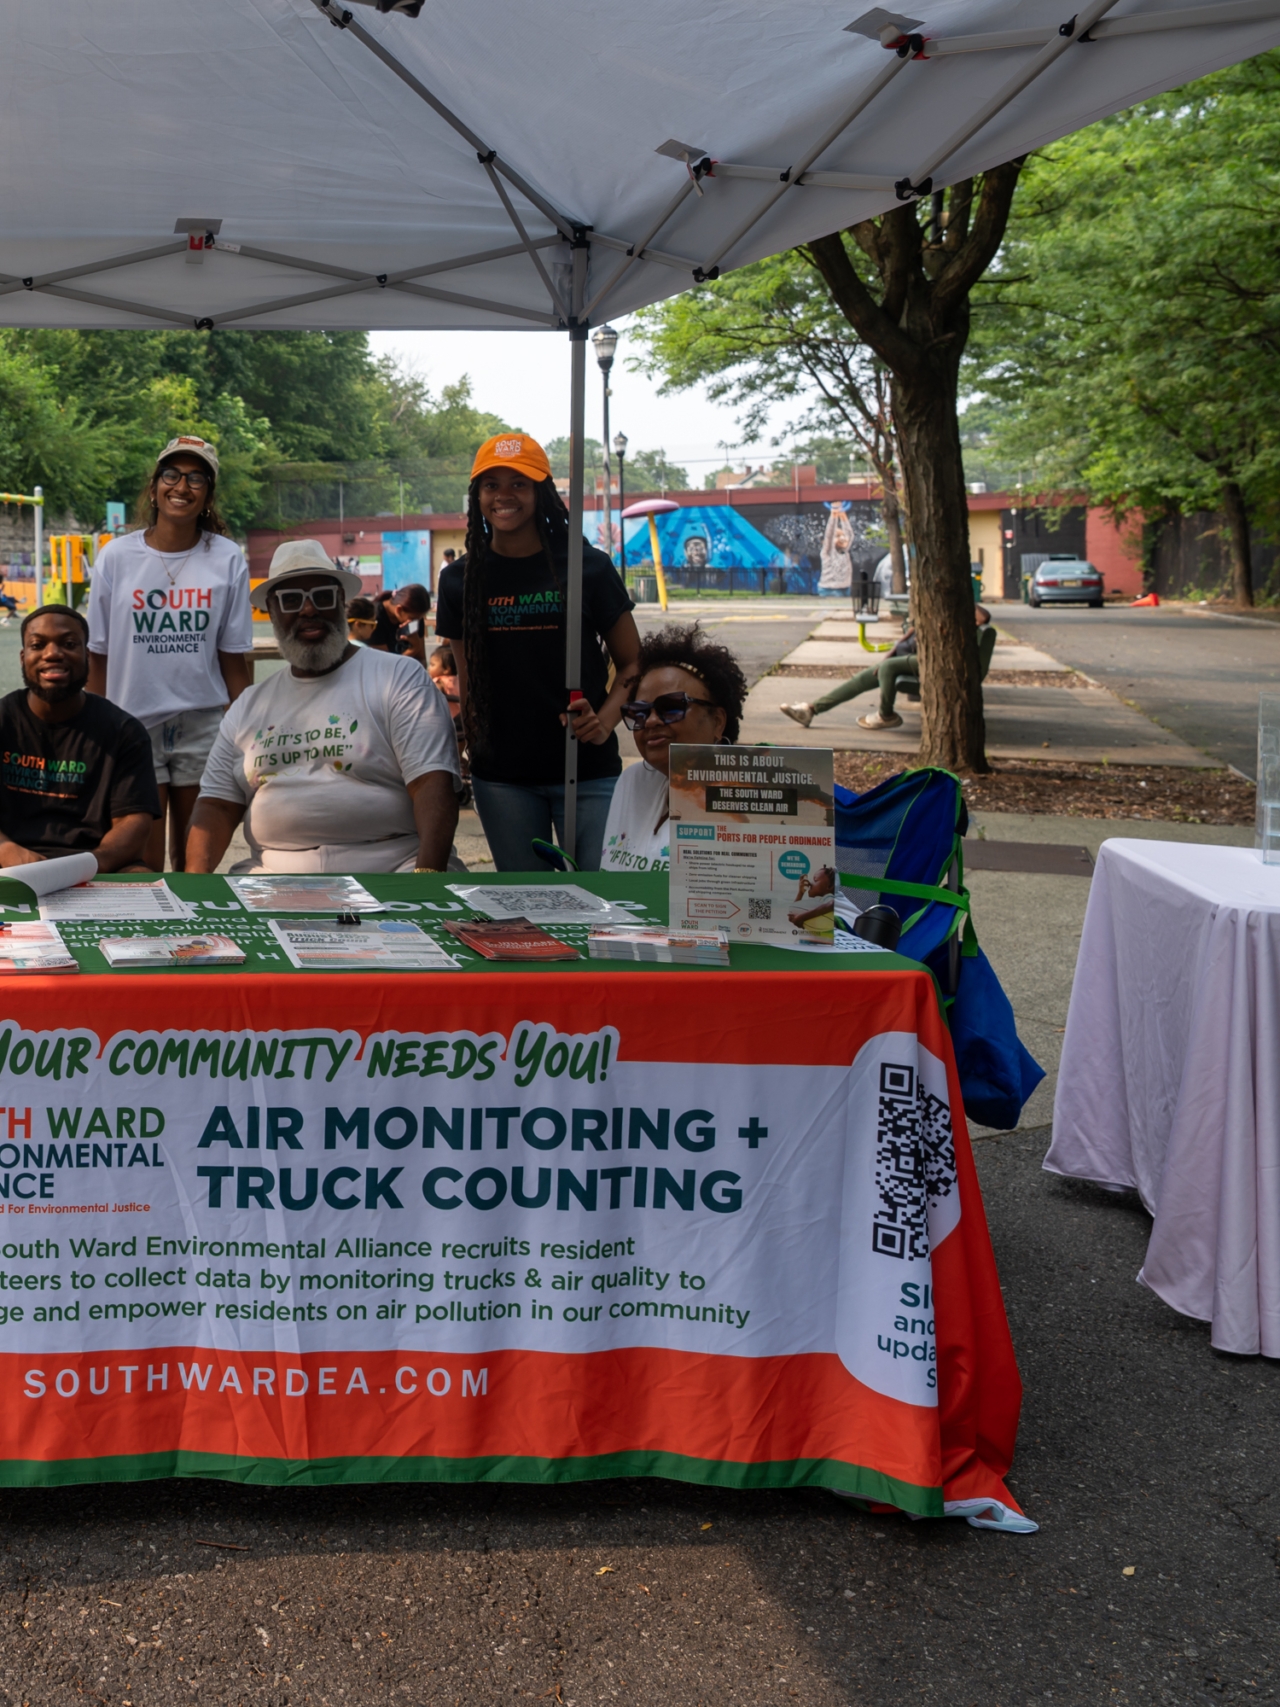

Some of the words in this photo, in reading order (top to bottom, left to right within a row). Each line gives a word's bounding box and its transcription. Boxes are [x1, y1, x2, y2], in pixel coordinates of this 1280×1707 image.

[496, 439, 521, 447] SOUTH
[496, 445, 521, 453] WARD
[132, 589, 211, 610] SOUTH
[488, 595, 515, 606] UTH
[132, 610, 210, 633] WARD
[133, 633, 206, 643] ENVIRONMENTAL
[147, 643, 199, 654] ALLIANCE
[305, 729, 320, 743] TO
[324, 728, 346, 740] BE,
[2, 751, 45, 770] SOUTH
[47, 760, 87, 773] WARD
[282, 751, 301, 765] UP
[304, 747, 319, 761] TO
[714, 754, 736, 766] THIS
[739, 755, 749, 767] IS
[752, 755, 785, 768] ABOUT
[687, 770, 769, 784] ENVIRONMENTAL
[772, 772, 816, 785] JUSTICE.
[720, 788, 733, 799] THE
[735, 788, 759, 799] SOUTH
[761, 789, 783, 800] WARD
[712, 801, 749, 812] DESERVES
[750, 802, 774, 813] CLEAN
[775, 803, 789, 813] AIR
[678, 827, 713, 838] SUPPORT
[716, 833, 741, 843] PORTS
[743, 833, 757, 844] FOR
[759, 834, 787, 845] PEOPLE
[789, 835, 832, 847] ORDINANCE
[632, 855, 649, 871] TO
[108, 1038, 353, 1083] COMMUNITY
[366, 1036, 499, 1083] NEEDS
[46, 1107, 166, 1140] WARD
[196, 1105, 304, 1150] AIR
[323, 1106, 716, 1153] MONITORING
[196, 1165, 406, 1212] TRUCK
[422, 1166, 744, 1215] COUNTING
[8, 1203, 24, 1214] For
[28, 1202, 110, 1215] Environmental
[111, 1202, 151, 1214] Justice
[68, 1237, 138, 1259] Ward
[146, 1236, 327, 1260] Environmental
[335, 1237, 432, 1259] Alliance
[441, 1236, 531, 1259] recruits
[540, 1236, 636, 1260] resident
[70, 1270, 96, 1290] to
[104, 1267, 187, 1289] collect
[194, 1267, 252, 1290] data
[260, 1269, 291, 1294] by
[299, 1268, 435, 1297] monitoring
[443, 1267, 516, 1291] trucks
[524, 1267, 543, 1289] &
[550, 1267, 585, 1291] air
[590, 1266, 670, 1297] quality
[679, 1269, 707, 1291] to
[32, 1300, 81, 1323] and
[88, 1299, 207, 1326] empower
[215, 1299, 328, 1323] residents
[336, 1303, 368, 1322] on
[376, 1299, 408, 1321] air
[414, 1299, 522, 1326] pollution
[530, 1300, 554, 1322] in
[562, 1304, 601, 1324] our
[608, 1302, 752, 1331] community
[23, 1361, 489, 1399] SOUTHWARDEA.COM
